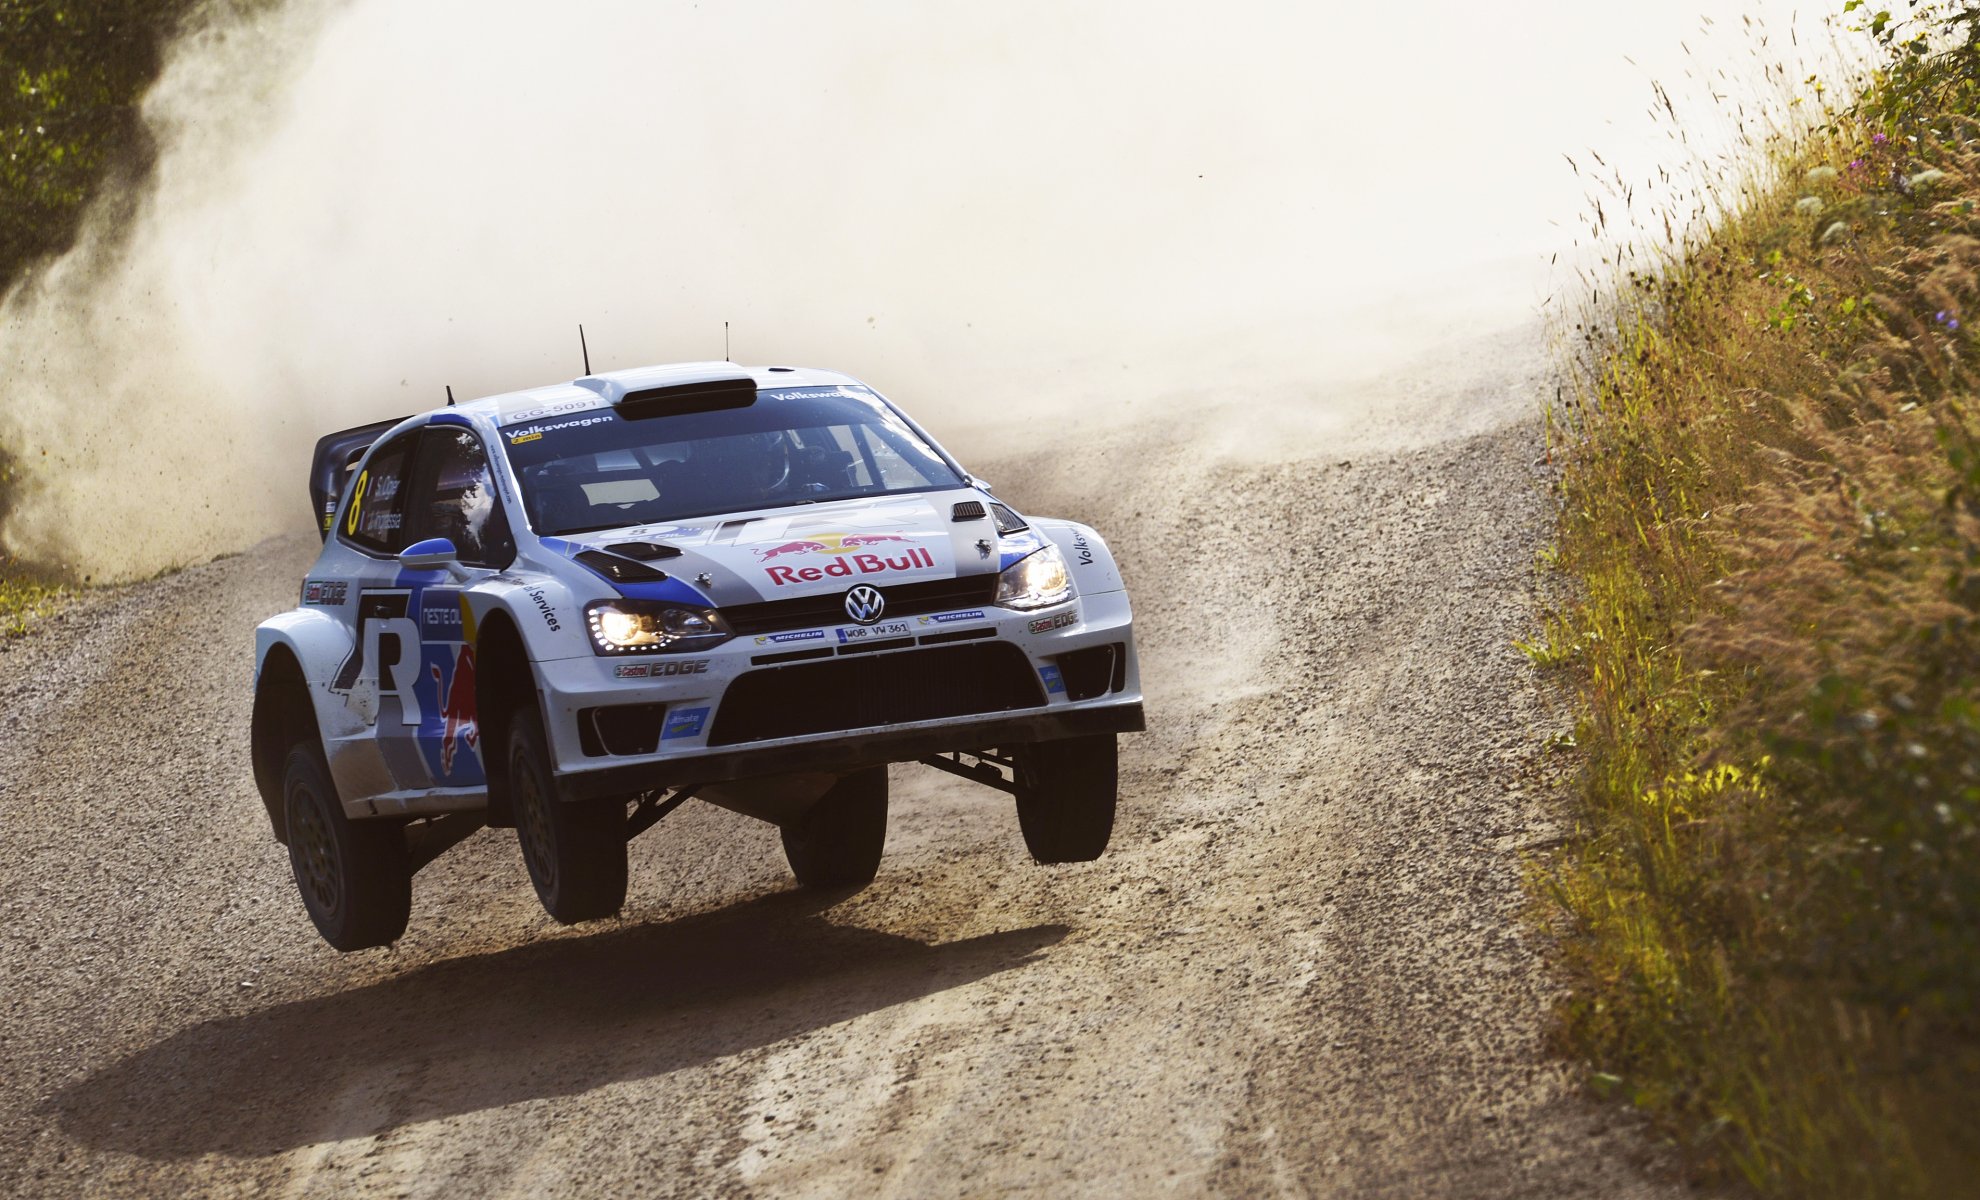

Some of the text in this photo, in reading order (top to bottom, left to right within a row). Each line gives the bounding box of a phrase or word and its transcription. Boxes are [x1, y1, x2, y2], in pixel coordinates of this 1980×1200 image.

[505, 415, 614, 439] Volkswagen
[348, 469, 368, 536] 8
[764, 547, 935, 586] Red Bull
[529, 590, 561, 632] Services
[937, 611, 983, 621] MICHELIN
[775, 631, 823, 641] MICHELIN
[846, 624, 908, 638] WOB VW 361
[366, 617, 422, 726] R
[650, 659, 711, 677] EDGE
